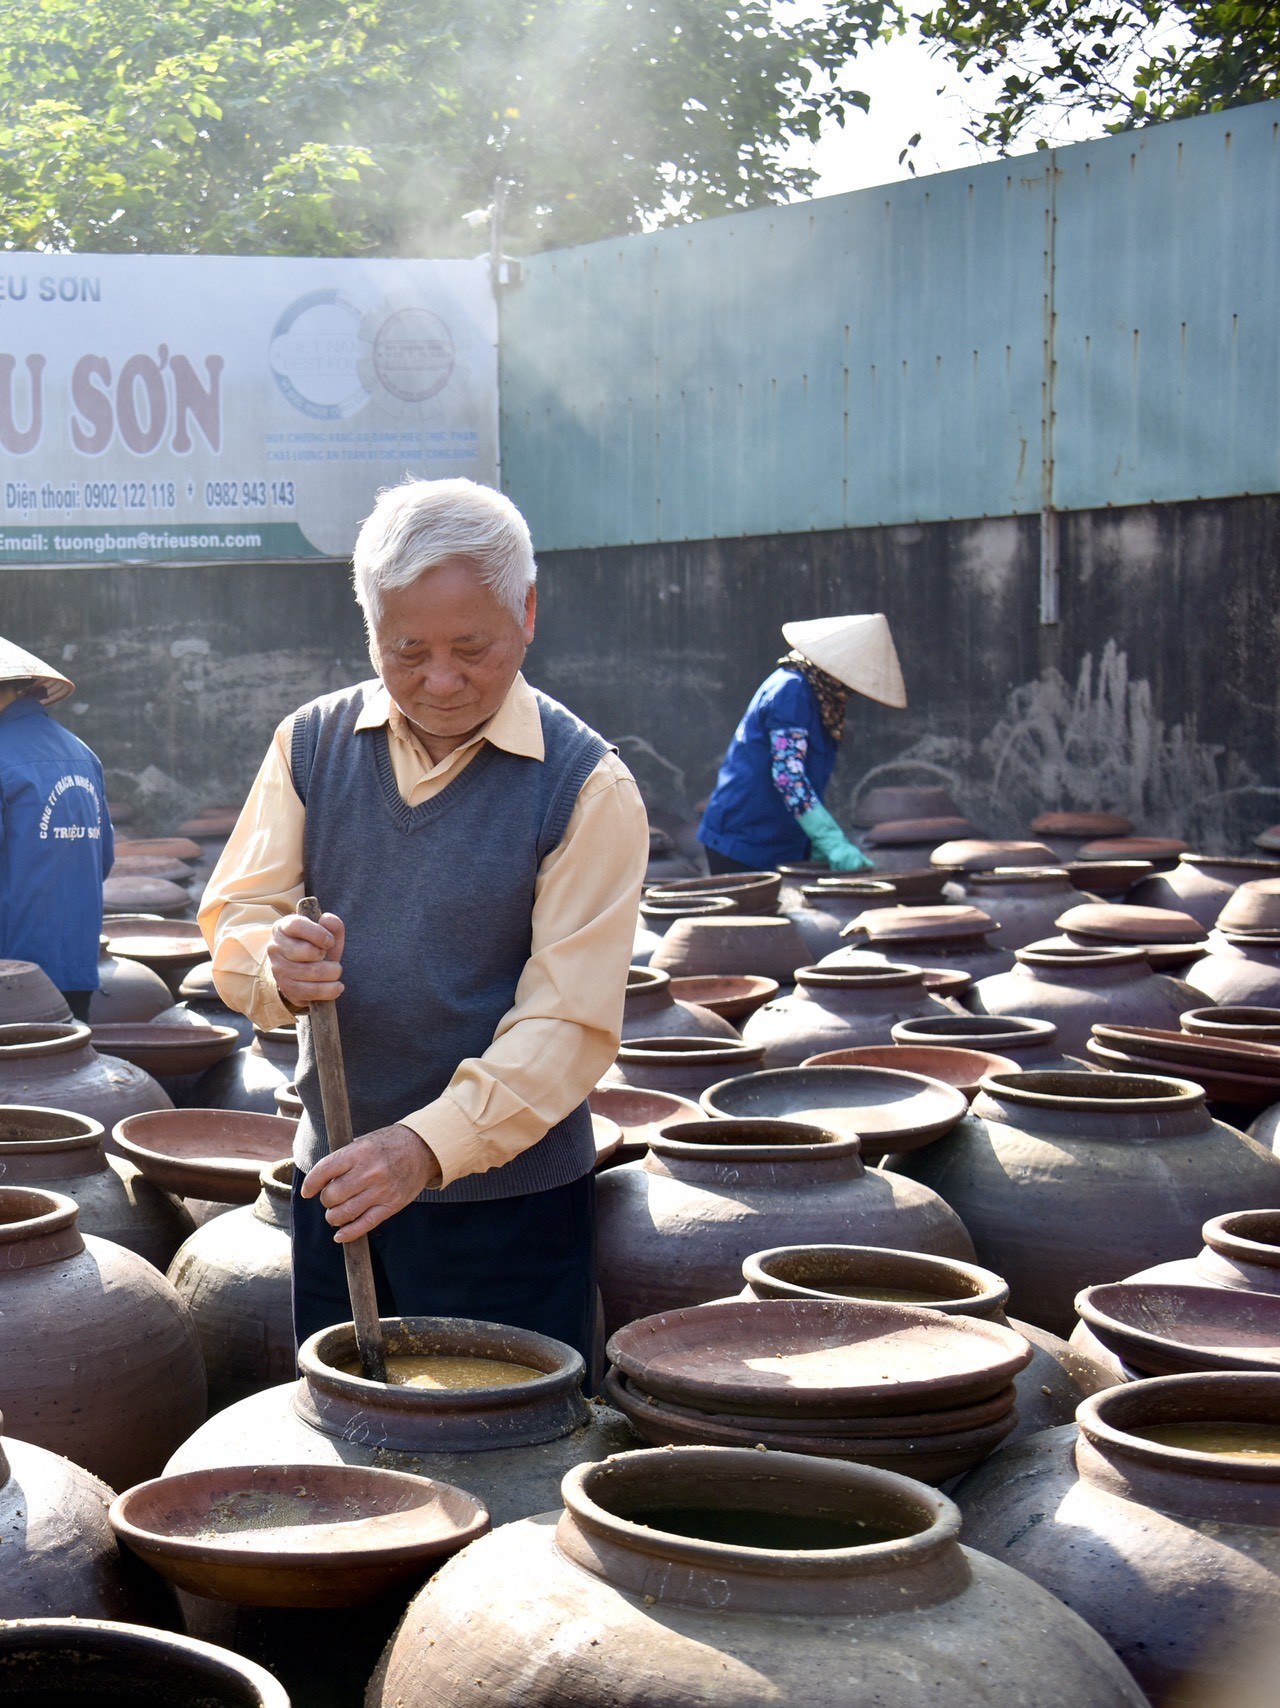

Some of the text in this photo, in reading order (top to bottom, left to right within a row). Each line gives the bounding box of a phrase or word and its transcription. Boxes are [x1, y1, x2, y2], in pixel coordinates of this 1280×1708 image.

[39, 275, 101, 302] SƠN
[71, 343, 224, 456] SƠN
[6, 483, 37, 517] Điện
[42, 482, 80, 517] thoại:
[84, 483, 117, 508] 0902
[123, 483, 146, 508] 122
[152, 482, 175, 507] 118
[206, 482, 238, 507] 0982
[242, 481, 267, 507] 943
[272, 481, 295, 506] 143
[54, 531, 261, 554] tuongban@trieuson.com
[53, 824, 86, 841] TRIỆU
